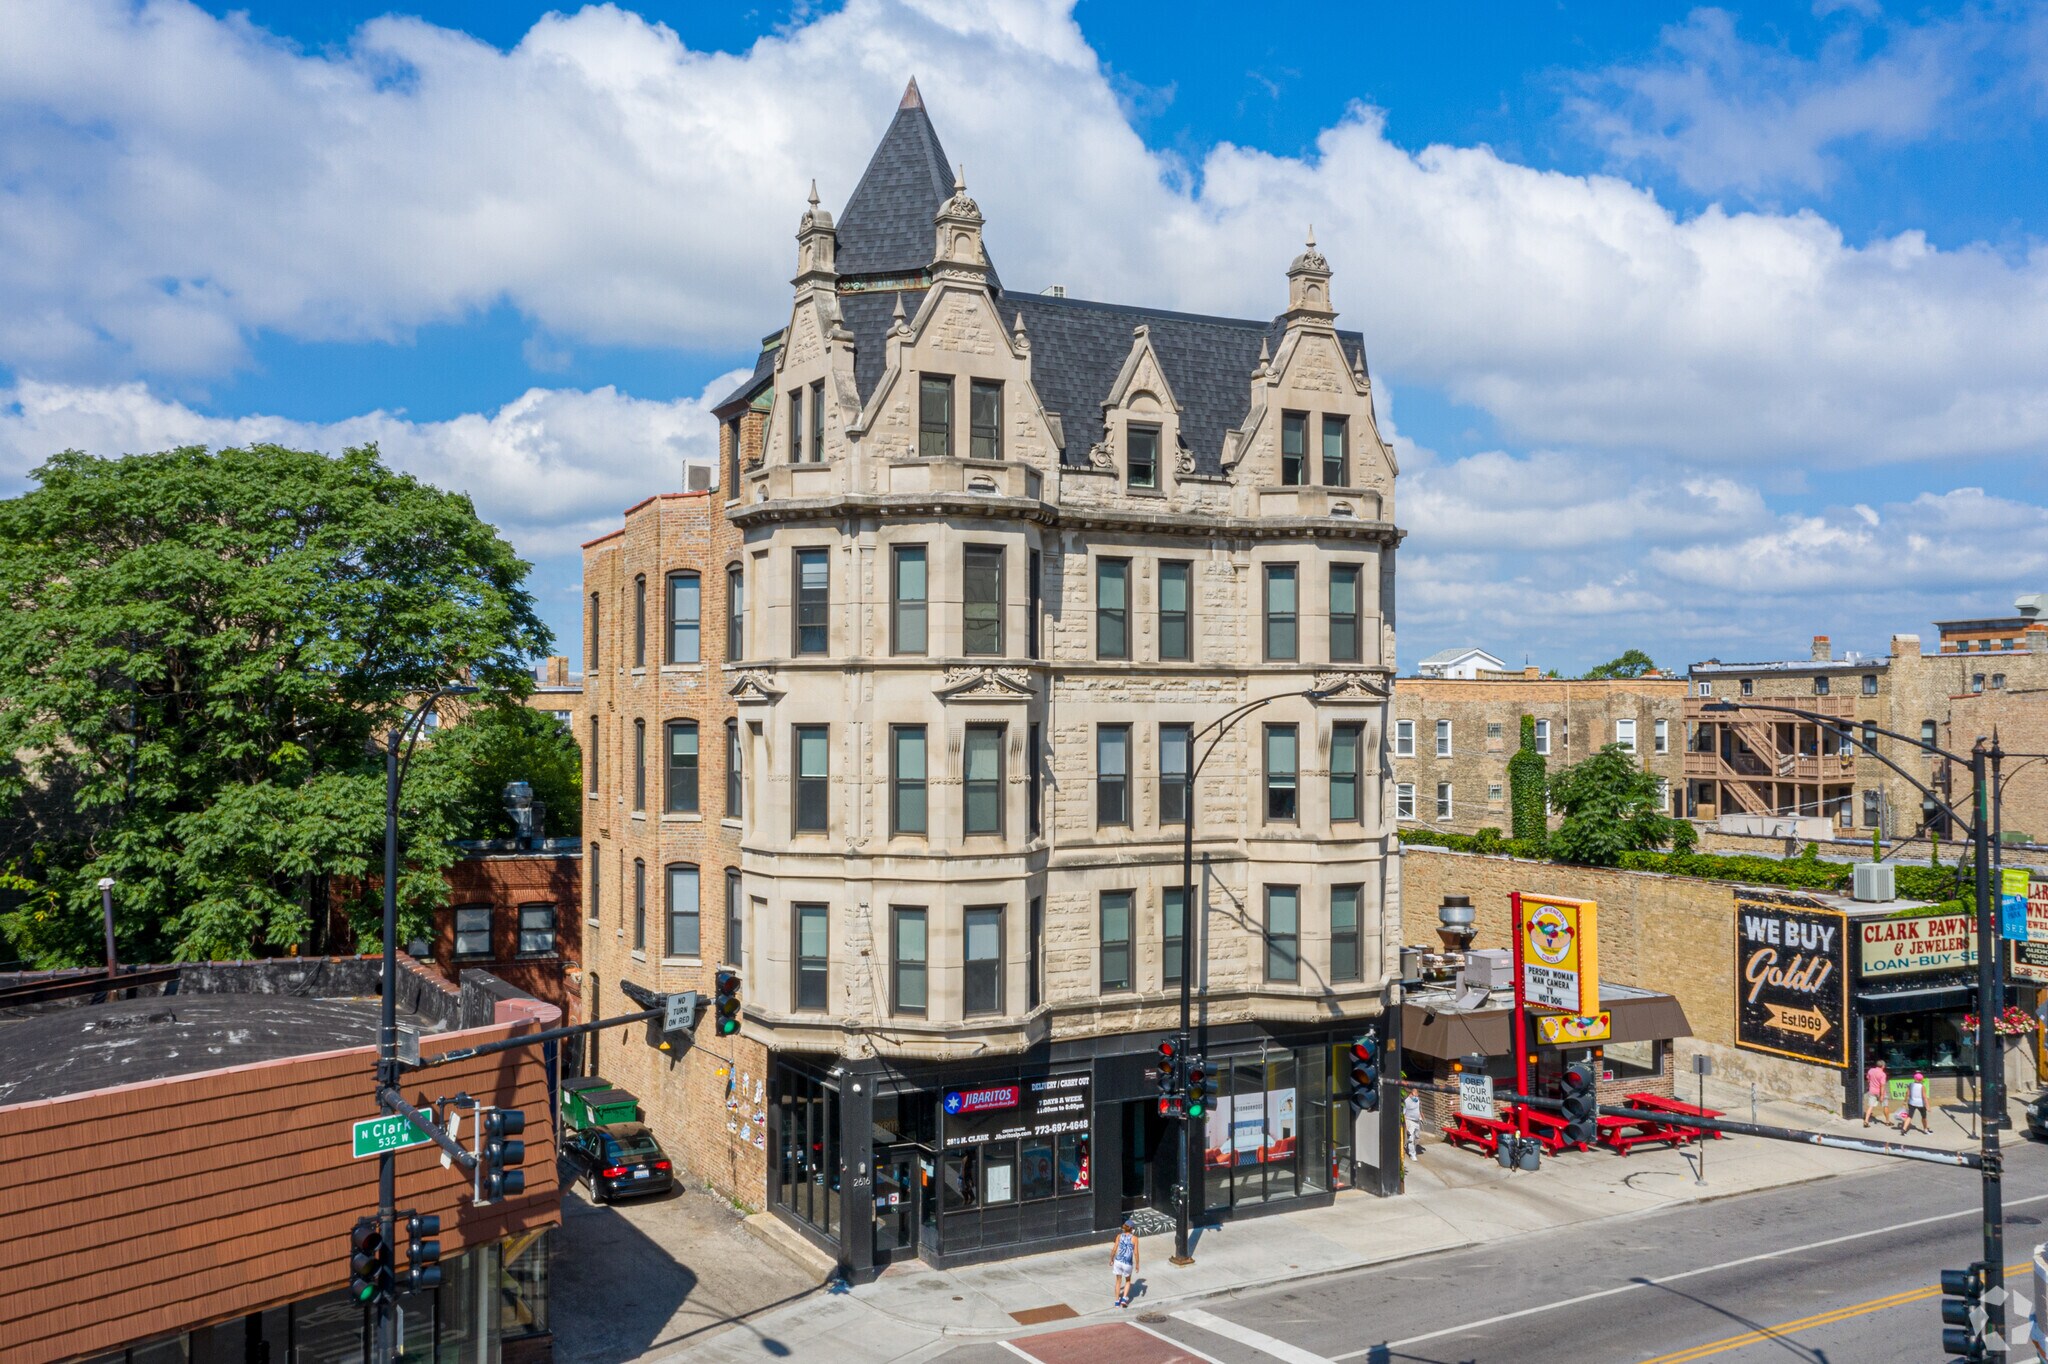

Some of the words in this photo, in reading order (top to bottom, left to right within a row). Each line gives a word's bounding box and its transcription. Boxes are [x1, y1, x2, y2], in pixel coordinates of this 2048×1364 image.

[2027, 882, 2048, 901] LAR
[1744, 915, 1780, 945] WE
[1785, 920, 1836, 952] BUY
[1863, 921, 1919, 944] CLARK
[1928, 914, 1996, 937] PAWNE
[1893, 942, 1904, 956] &
[1909, 937, 1970, 955] JEWELERS
[1864, 951, 1979, 972] LOAN-BUY-SE
[1528, 966, 1550, 977] PERSON
[1553, 970, 1574, 981] WOMAN
[1745, 948, 1833, 1004] Gold!
[2014, 967, 2048, 979] 528-79
[1532, 976, 1545, 985] MAN
[1546, 978, 1570, 990] CAMERA
[1546, 987, 1554, 995] TV
[677, 996, 686, 1005] NO
[1538, 994, 1550, 1003] HOT
[1551, 996, 1562, 1006] DOG
[673, 1006, 688, 1016] TURN
[668, 1018, 677, 1027] ON
[678, 1015, 690, 1024] RED
[1031, 1080, 1057, 1091] DELIVERY
[1060, 1078, 1078, 1088] CARRY
[1078, 1077, 1090, 1086] OUT
[1465, 1077, 1486, 1087] OBEY
[1465, 1085, 1487, 1095] YOUR
[963, 1089, 1012, 1108] JIBARITOS
[1463, 1093, 1491, 1104] SIGNAL
[1467, 1102, 1487, 1112] ONLY
[361, 1130, 369, 1139] N
[372, 1118, 412, 1137] Clark
[1034, 1119, 1089, 1135] 773-697-4648
[378, 1135, 397, 1148] 532
[401, 1132, 409, 1142] W
[967, 1133, 990, 1143] CLARK
[853, 1177, 871, 1187] 2616
